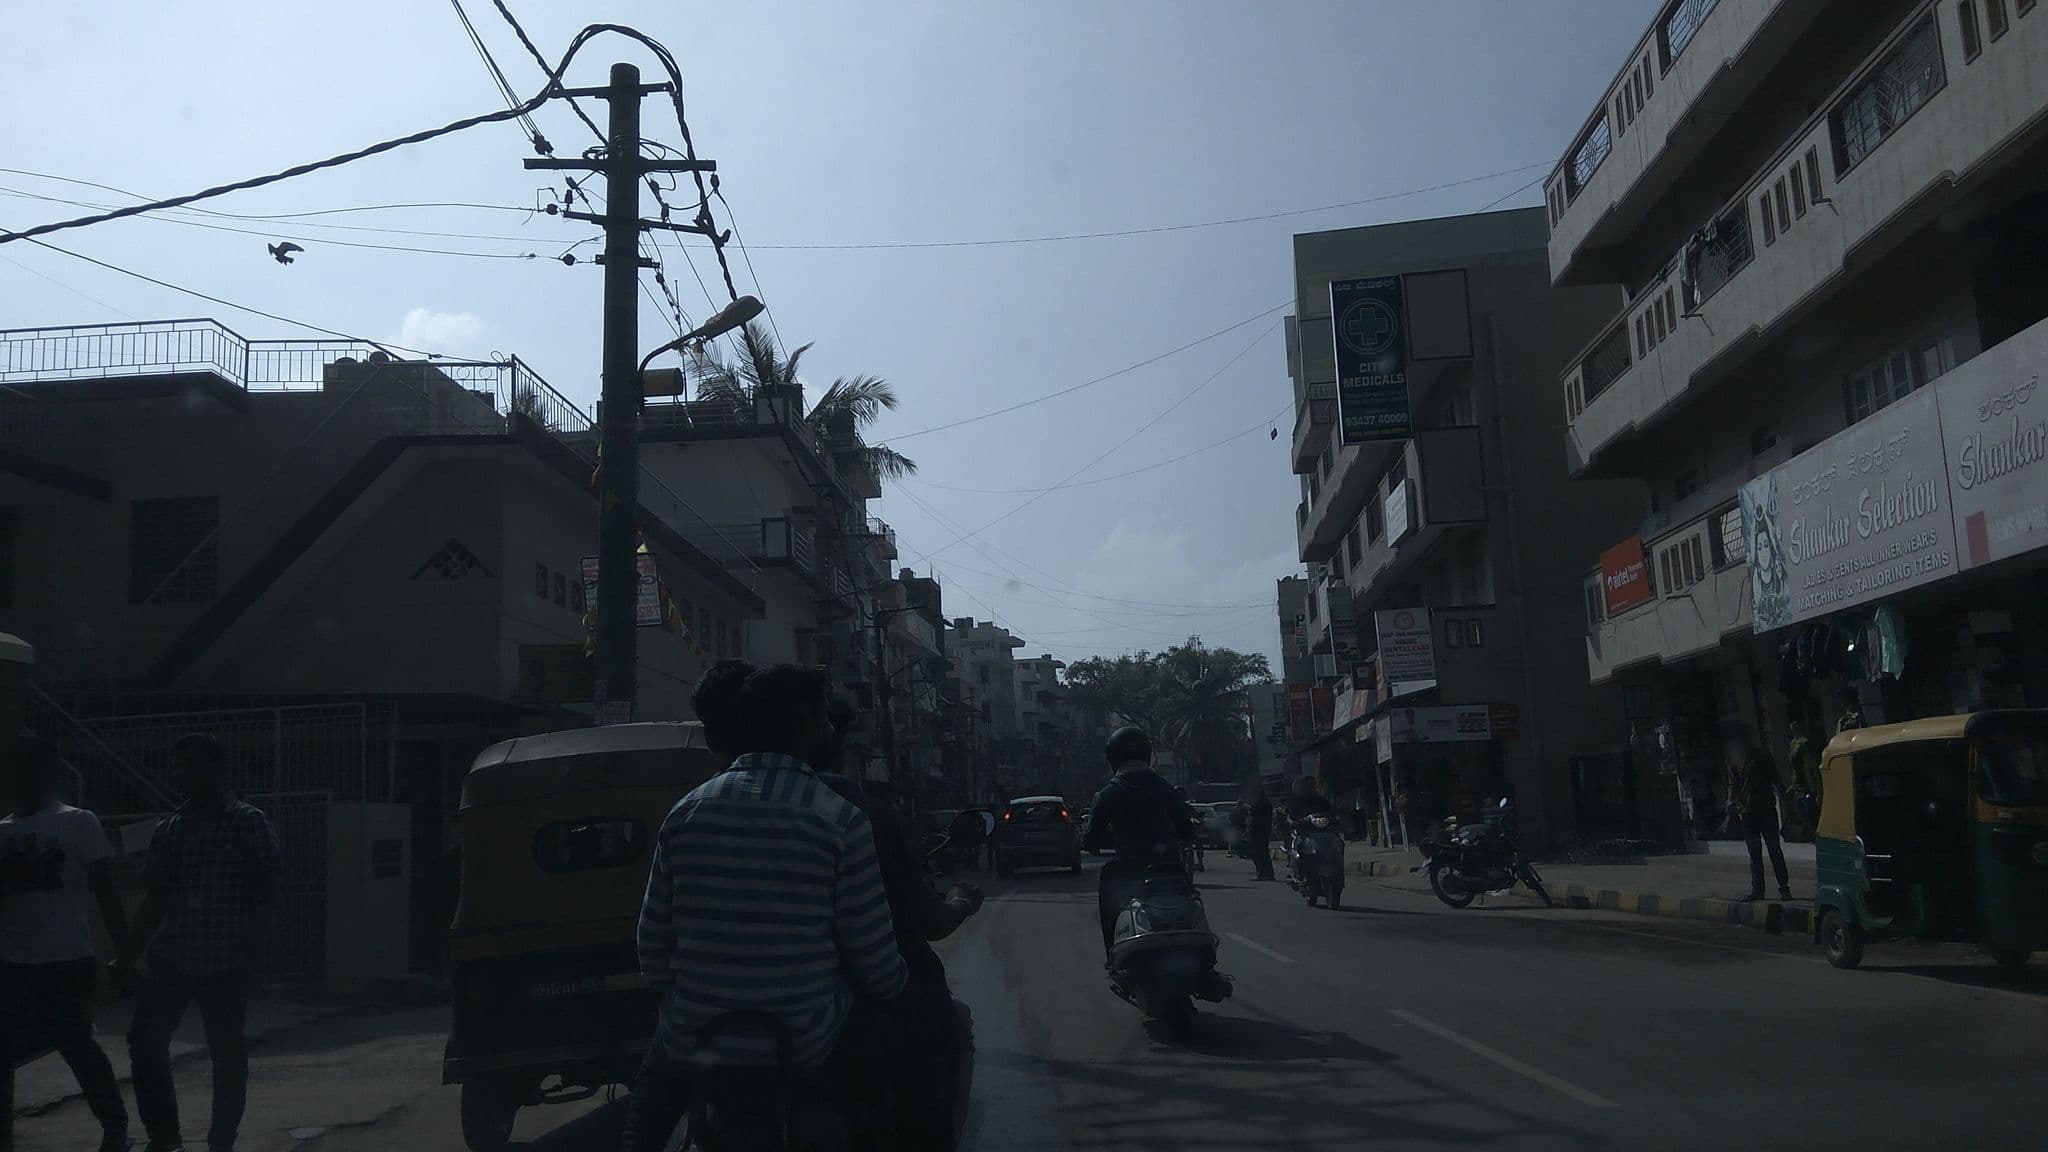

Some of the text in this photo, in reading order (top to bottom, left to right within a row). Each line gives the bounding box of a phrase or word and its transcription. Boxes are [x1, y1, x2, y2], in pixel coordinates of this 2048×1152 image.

[1343, 373, 1404, 388] MEDICALS
[1958, 415, 2048, 490] Shankar
[1790, 504, 1851, 566] Shankar
[1857, 469, 1939, 539] Selection
[1799, 551, 1951, 612] MATCHING & TAILORING ITEMS
[1802, 571, 1827, 590] LADIES
[1836, 558, 1860, 580] GENTS
[1861, 553, 1876, 570] ALL
[1877, 544, 1903, 565] INNER
